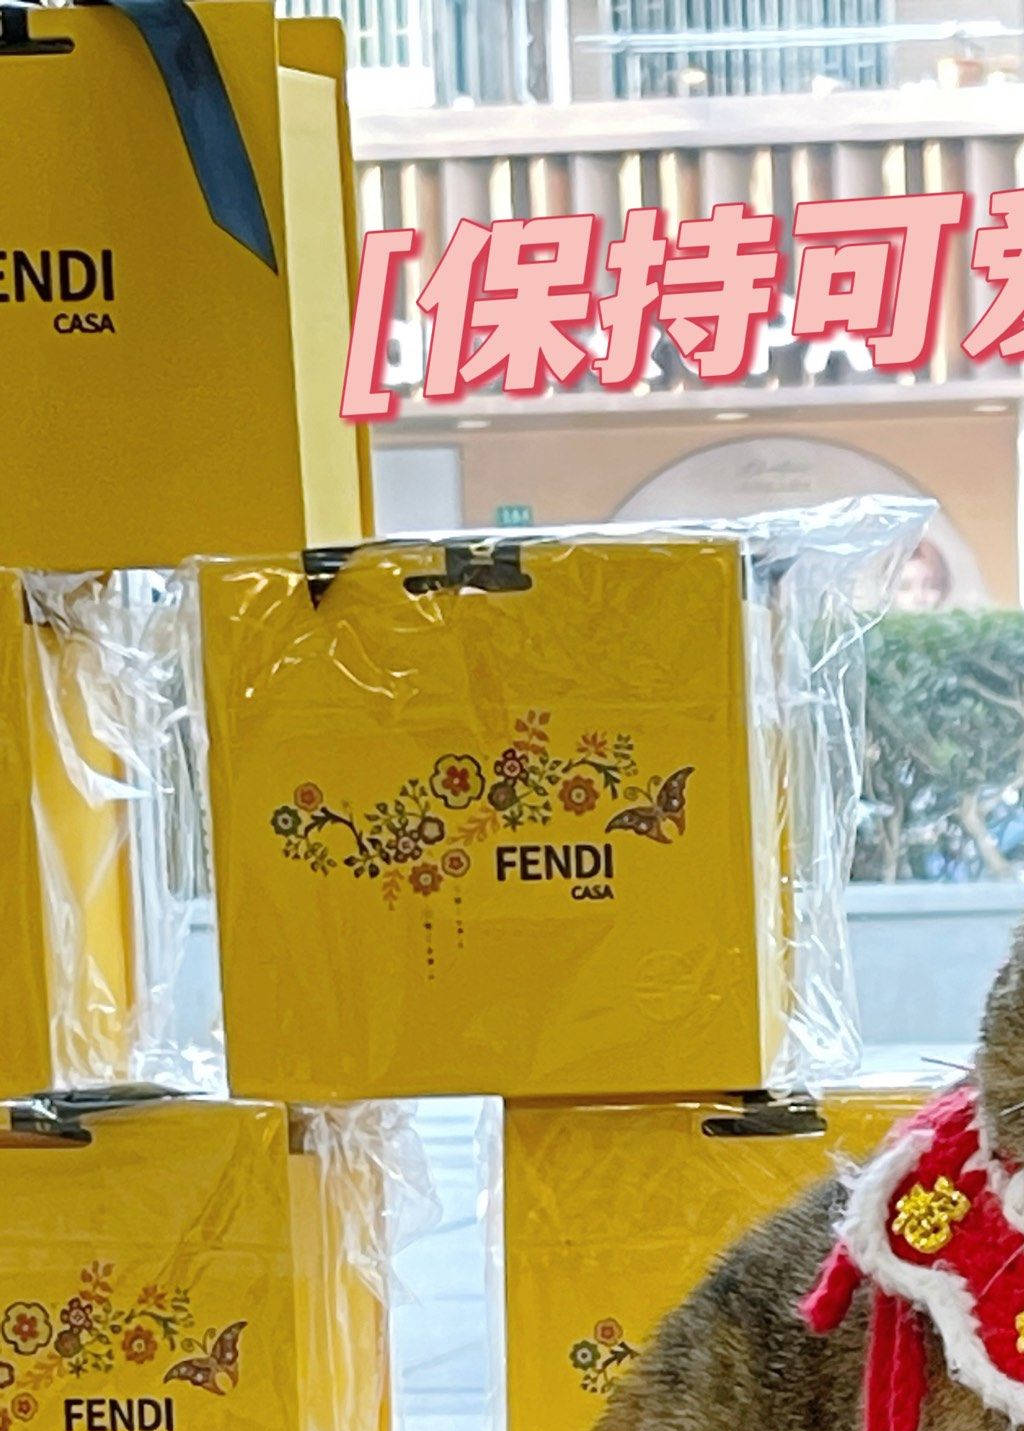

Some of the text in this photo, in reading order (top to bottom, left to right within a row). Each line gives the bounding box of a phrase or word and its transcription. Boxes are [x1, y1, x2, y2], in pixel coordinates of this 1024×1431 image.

[53, 312, 115, 333] CASA
[496, 843, 613, 881] FENDI
[571, 884, 614, 899] CASA
[64, 1397, 174, 1431] FENDI
